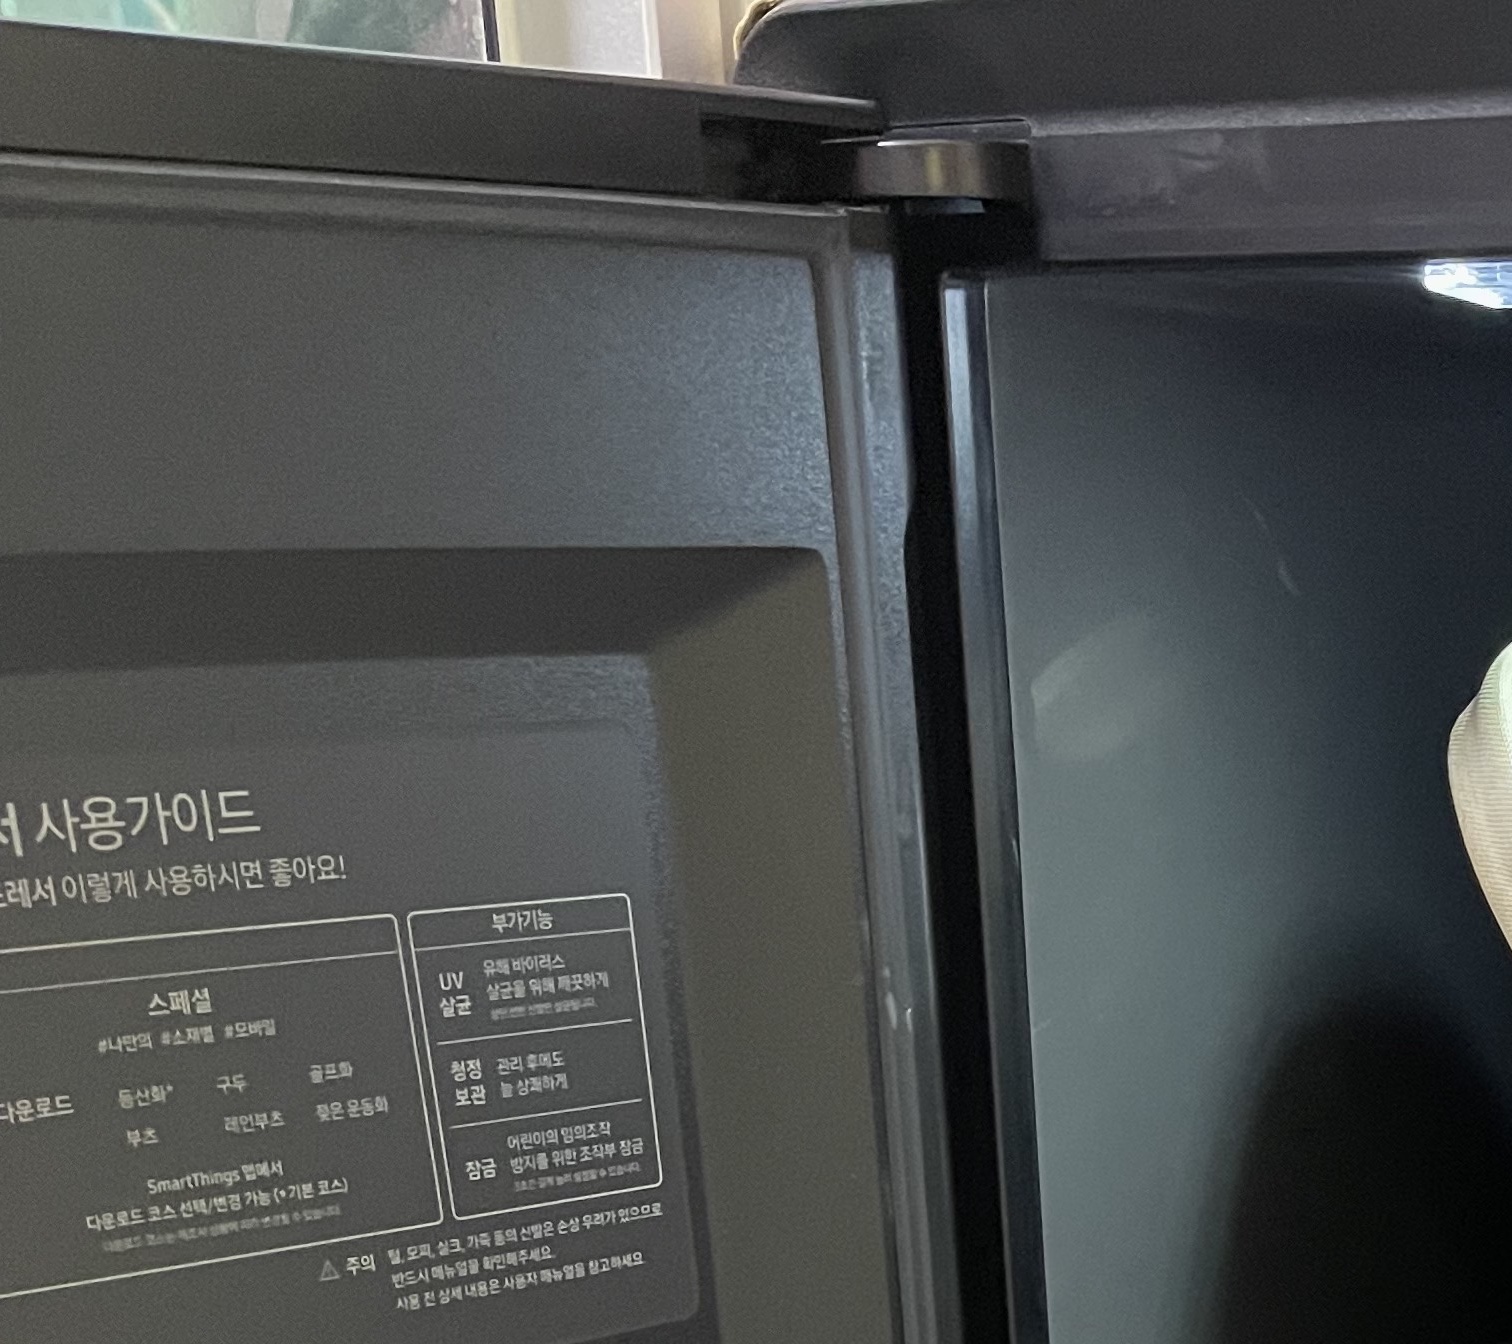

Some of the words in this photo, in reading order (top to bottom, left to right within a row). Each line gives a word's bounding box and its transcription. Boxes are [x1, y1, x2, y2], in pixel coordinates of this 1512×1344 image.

[35, 789, 261, 853] 사용가이드
[0, 876, 57, 908] 레서
[61, 869, 138, 904] 이렇게
[144, 859, 264, 896] 사용하시면
[269, 854, 347, 887] 좋아요!
[492, 909, 553, 933] 부가기능
[511, 953, 566, 974] 바이러스
[438, 971, 464, 991] UV
[148, 987, 213, 1016] 스페셜
[439, 994, 472, 1018] 살균
[450, 1058, 482, 1082] 청정
[496, 1055, 524, 1075] 관리
[216, 1073, 248, 1094] 구두
[455, 1084, 487, 1107] 보관
[347, 1095, 389, 1119] 운동화
[126, 1127, 159, 1147] 부츠
[507, 1128, 559, 1151] 어린이의
[560, 1121, 611, 1144] 임의조작
[510, 1152, 549, 1174] 방지를
[552, 1149, 577, 1168] 위한
[579, 1142, 617, 1162] 조작부
[619, 1137, 644, 1157] 잠금
[147, 1168, 240, 1194] SmartThings
[465, 1157, 497, 1181] 잠금
[86, 1208, 145, 1231] 다운로드
[148, 1204, 177, 1222] 코스
[245, 1191, 271, 1207] 가능
[318, 1177, 348, 1197] 코스)
[557, 1217, 580, 1235] 손상
[582, 1211, 617, 1229] 우려가
[618, 1202, 663, 1224] 있으므로
[346, 1253, 376, 1276] 주의
[391, 1267, 430, 1289] 반드시
[396, 1293, 420, 1311] 사용
[423, 1290, 437, 1308] 전
[464, 1278, 501, 1297] 내용은
[503, 1271, 538, 1290] 사용자
